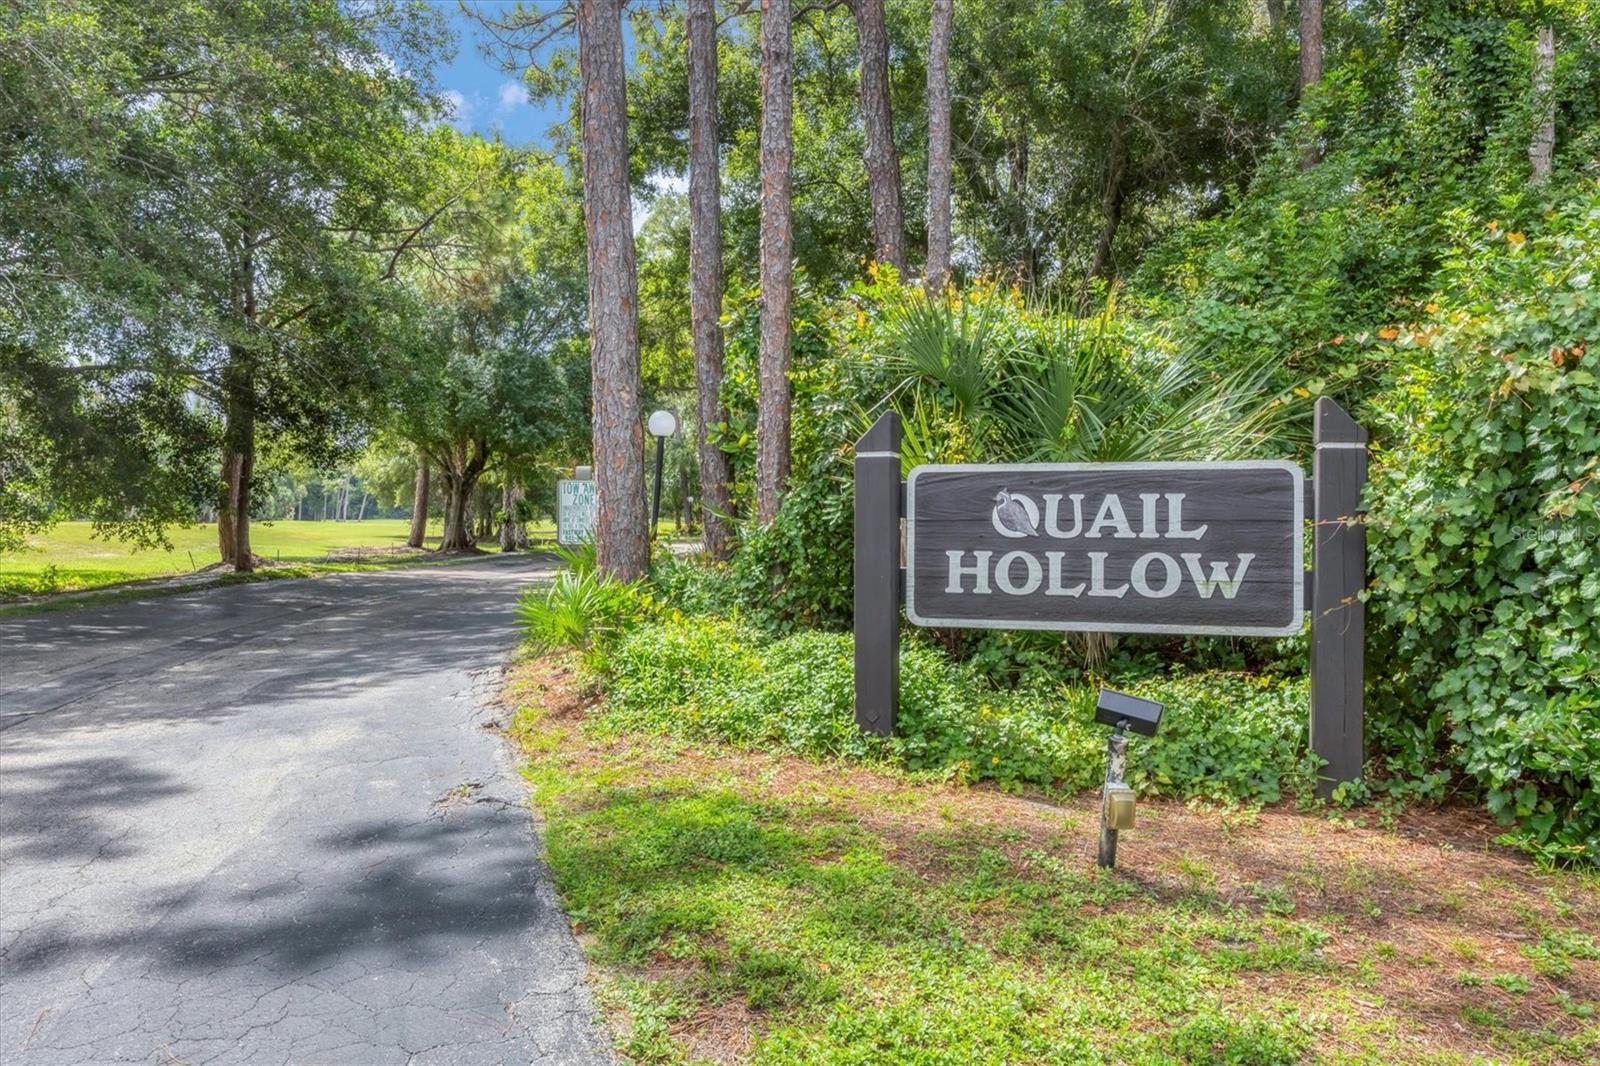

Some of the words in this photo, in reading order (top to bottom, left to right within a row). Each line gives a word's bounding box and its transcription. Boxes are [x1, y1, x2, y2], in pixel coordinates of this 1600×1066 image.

[562, 481, 579, 494] TOW
[582, 482, 595, 494] AW
[572, 494, 594, 505] ZONE
[991, 492, 1208, 541] QUAIL
[944, 549, 1256, 599] HOLLOW
